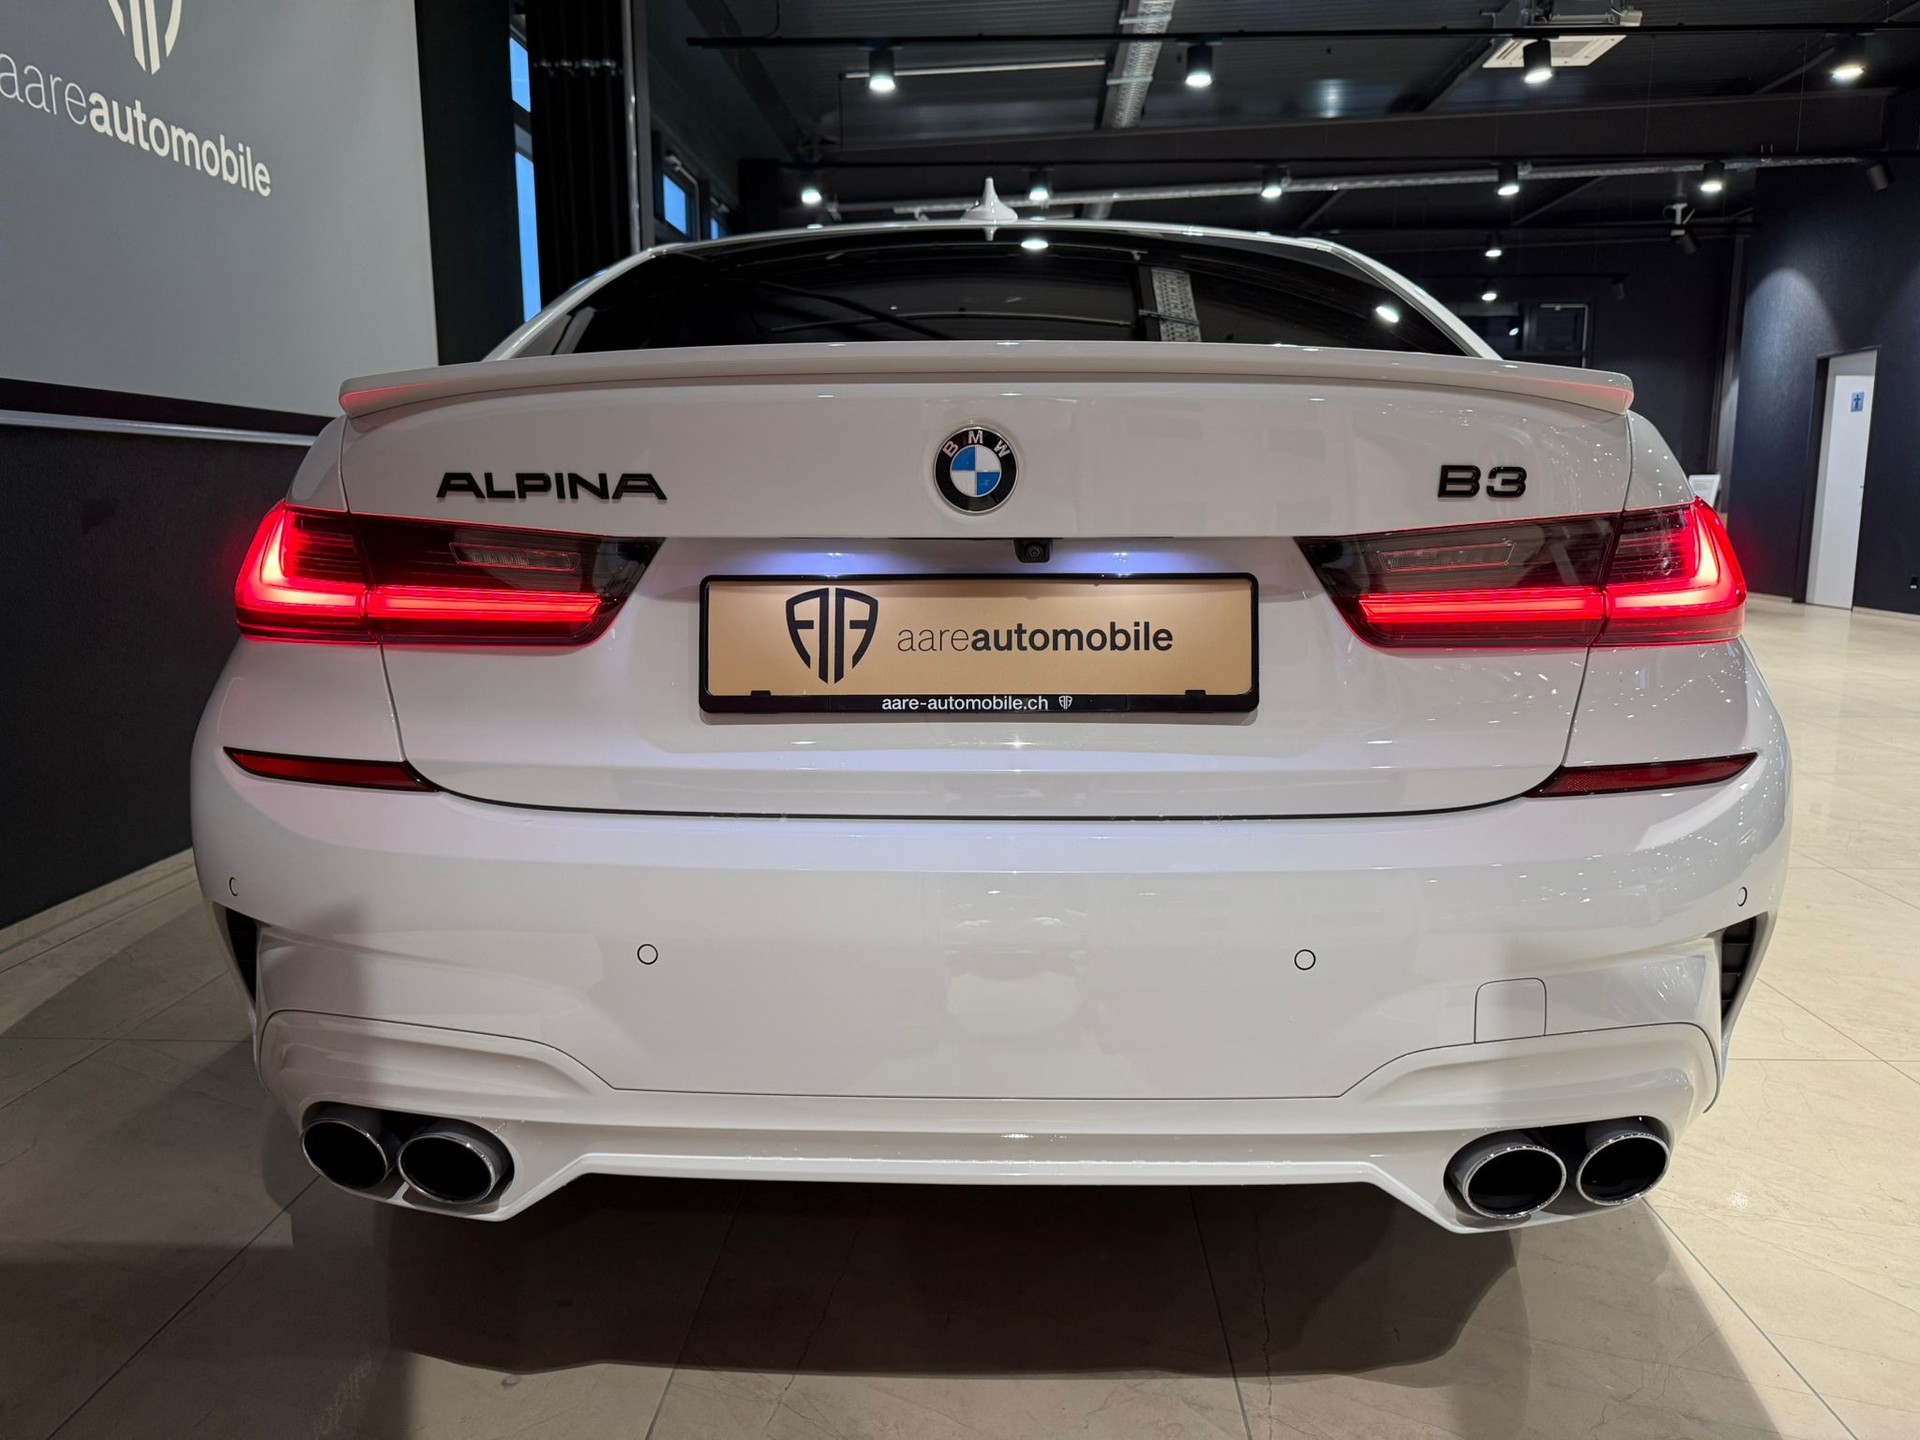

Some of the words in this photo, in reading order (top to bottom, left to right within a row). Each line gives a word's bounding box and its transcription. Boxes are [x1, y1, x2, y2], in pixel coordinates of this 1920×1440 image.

[0, 53, 271, 197] aareautomobile
[942, 430, 1011, 458] BMW
[436, 472, 667, 500] ALPINA
[1438, 464, 1527, 498] B3
[897, 621, 1173, 652] aareautomobile
[881, 695, 1049, 711] aare-automobile.ch
